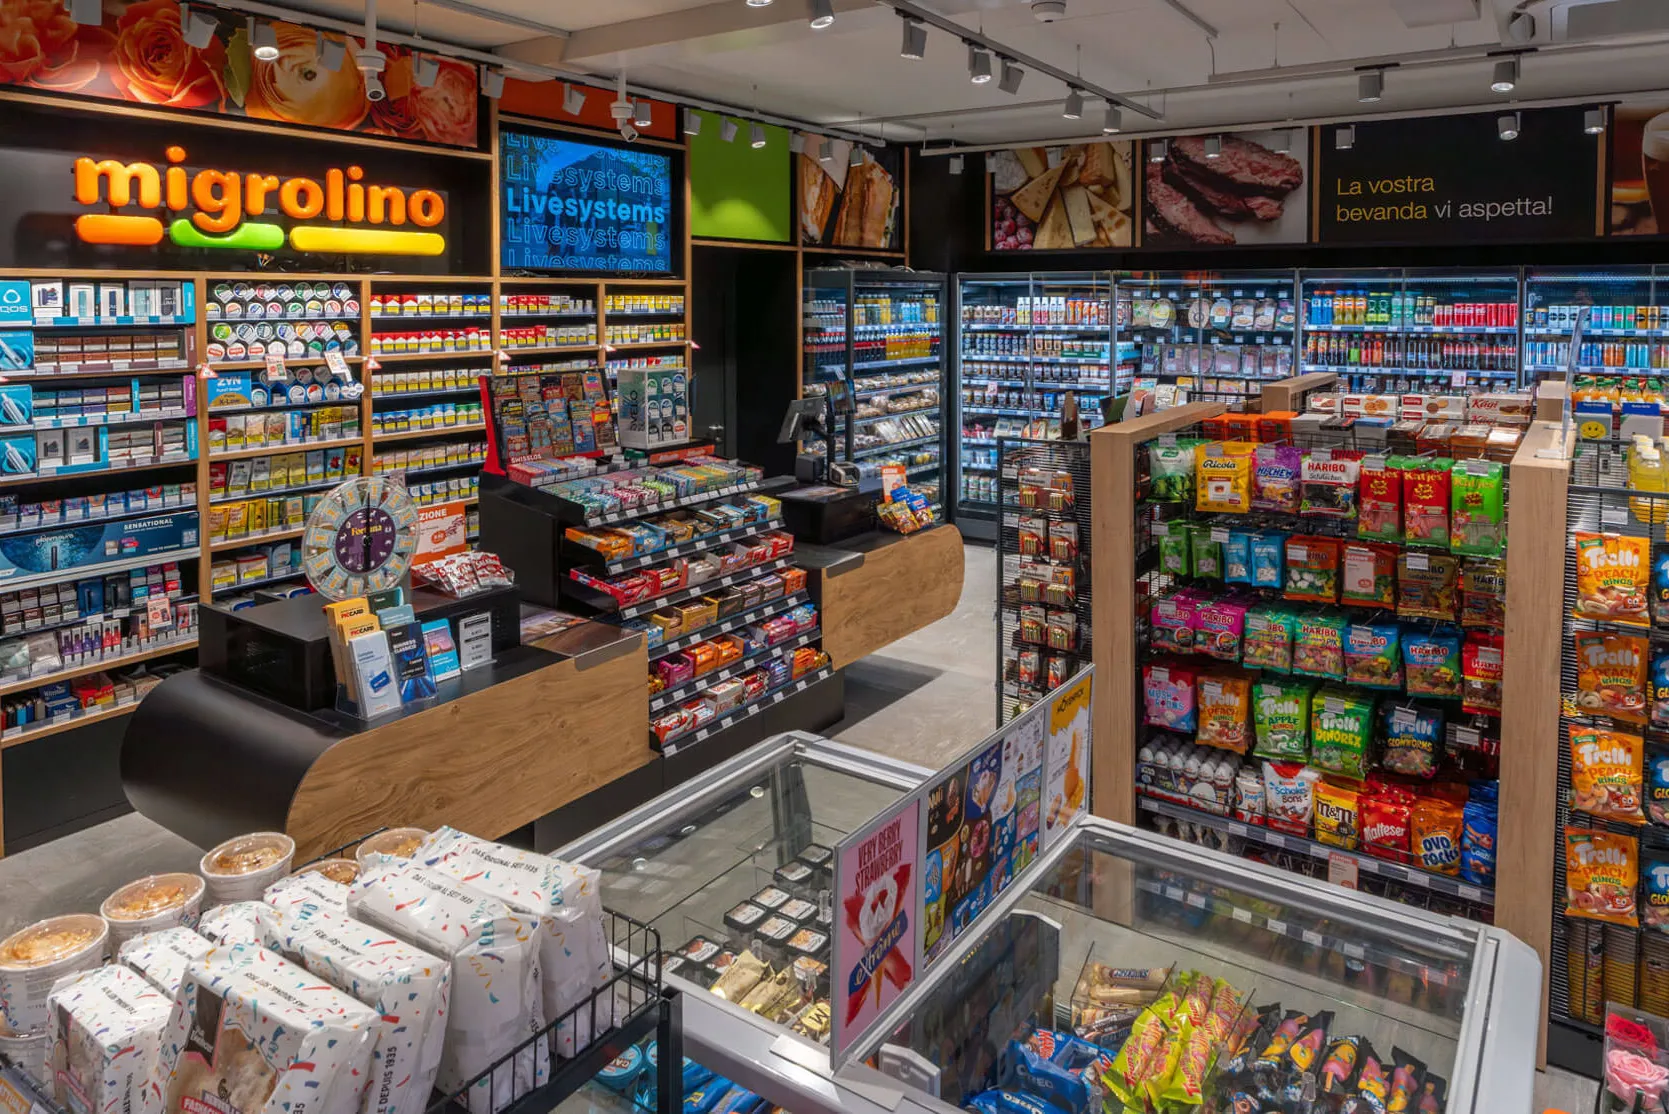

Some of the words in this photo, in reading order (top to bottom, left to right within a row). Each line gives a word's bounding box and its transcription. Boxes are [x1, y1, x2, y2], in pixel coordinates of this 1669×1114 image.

[74, 146, 445, 233] migrolino
[1336, 178, 1361, 195] La
[1368, 176, 1435, 194] vostra
[507, 187, 666, 224] Livesystems
[1336, 202, 1427, 222] bevanda
[1434, 201, 1452, 219] vi
[1458, 196, 1553, 221] aspetta!
[508, 217, 666, 251] Livesystems
[1202, 459, 1236, 470] Ricola
[1307, 462, 1346, 474] HARIBO
[1403, 471, 1445, 482] Katjes
[1453, 476, 1496, 489] Katjes
[123, 518, 174, 531] SENSATIONAL
[1584, 547, 1640, 569] Trolli
[1593, 568, 1640, 581] PEACH
[1201, 611, 1235, 626] HARIBO
[1302, 625, 1337, 637] HARIBO
[1584, 645, 1640, 668] Trolli
[1592, 666, 1640, 679] PEACH
[1260, 698, 1301, 716] Trolli
[1268, 716, 1301, 726] APPLE
[1319, 712, 1361, 733] Trolli
[1314, 730, 1362, 749] DINOREX
[1578, 744, 1633, 767] Trolli
[858, 833, 878, 867] VERY
[878, 817, 902, 850] BERRY
[1422, 836, 1451, 851] OVO
[471, 848, 485, 858] DAS
[484, 854, 511, 868] ORIGINAL
[1573, 843, 1628, 867] Trolli
[854, 839, 905, 896] STRAWBERRY
[1582, 866, 1628, 879] PEACH
[411, 873, 425, 884] DAS
[384, 1046, 397, 1069] 1935
[379, 1070, 394, 1105] DEPUIS
